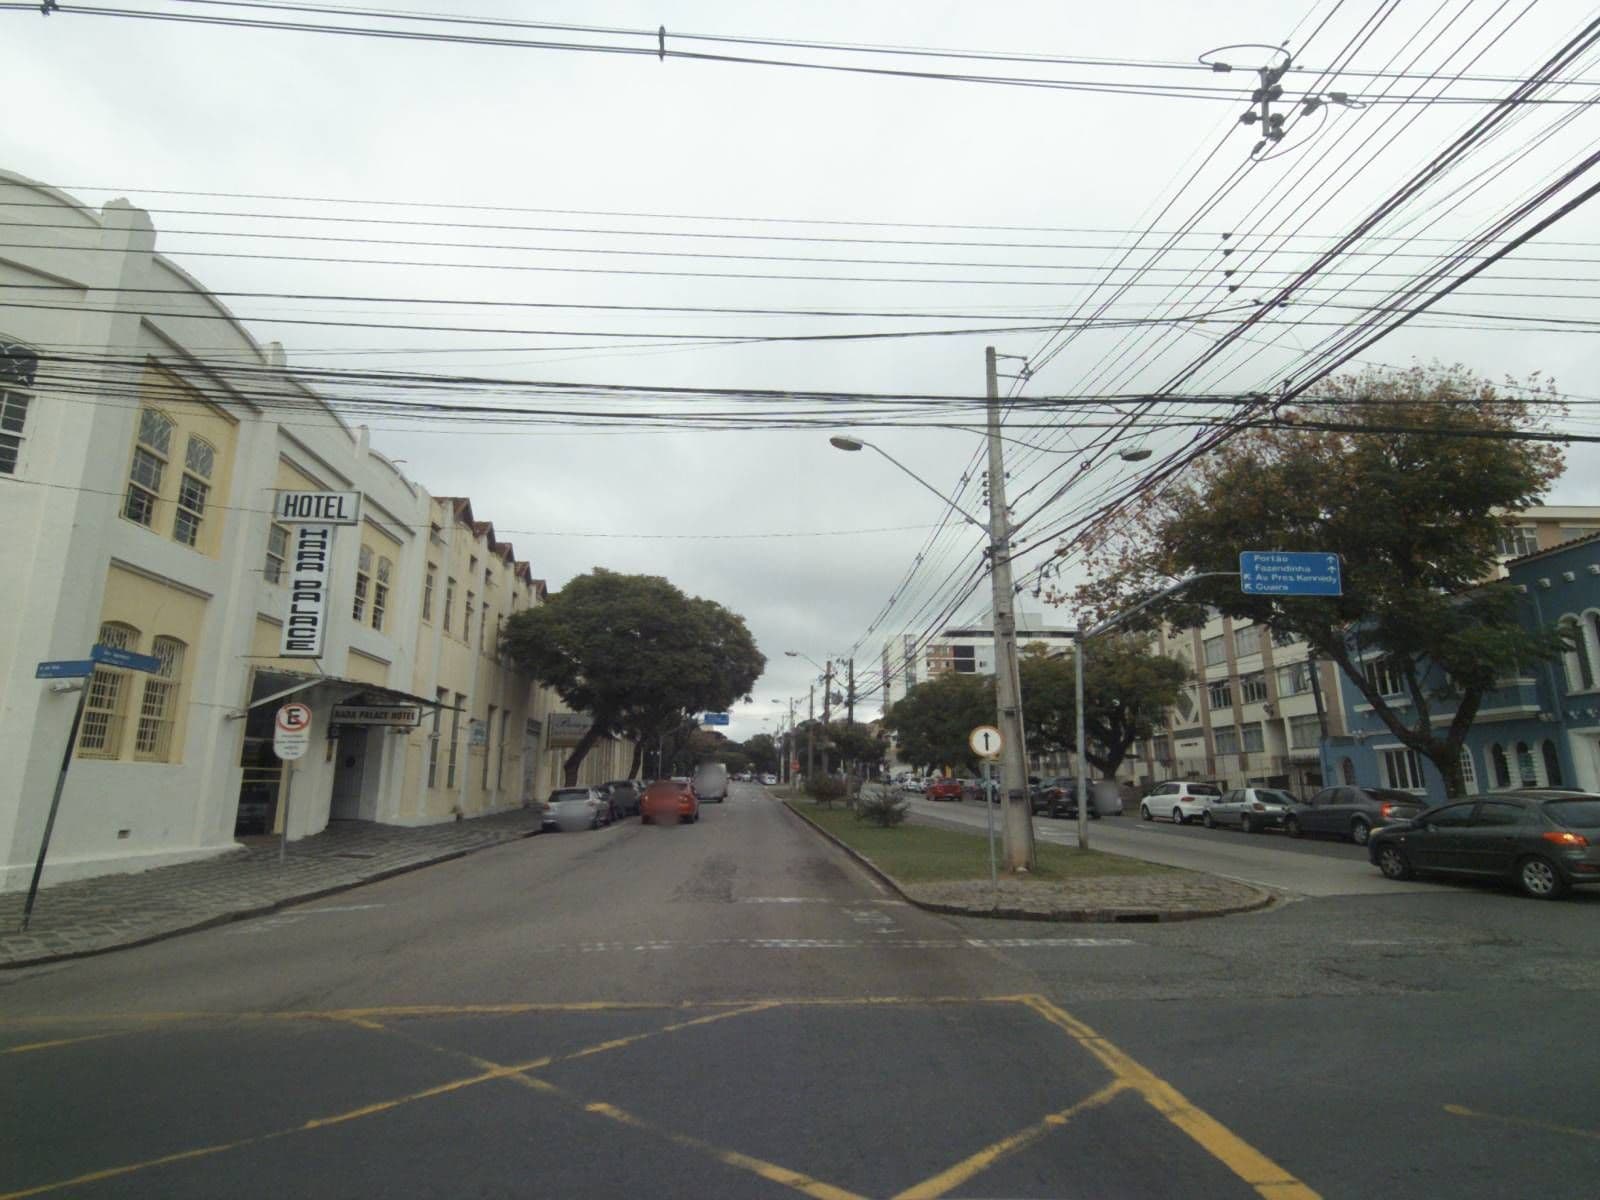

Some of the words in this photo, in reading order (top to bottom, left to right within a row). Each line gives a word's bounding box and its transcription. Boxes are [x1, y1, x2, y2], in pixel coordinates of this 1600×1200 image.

[284, 494, 348, 519] HOTEL
[296, 528, 328, 572] HARA
[1254, 564, 1312, 573] Fazendinha
[1296, 575, 1337, 584] Kennedy
[286, 580, 322, 651] PALACE
[391, 711, 415, 721] HOTEL
